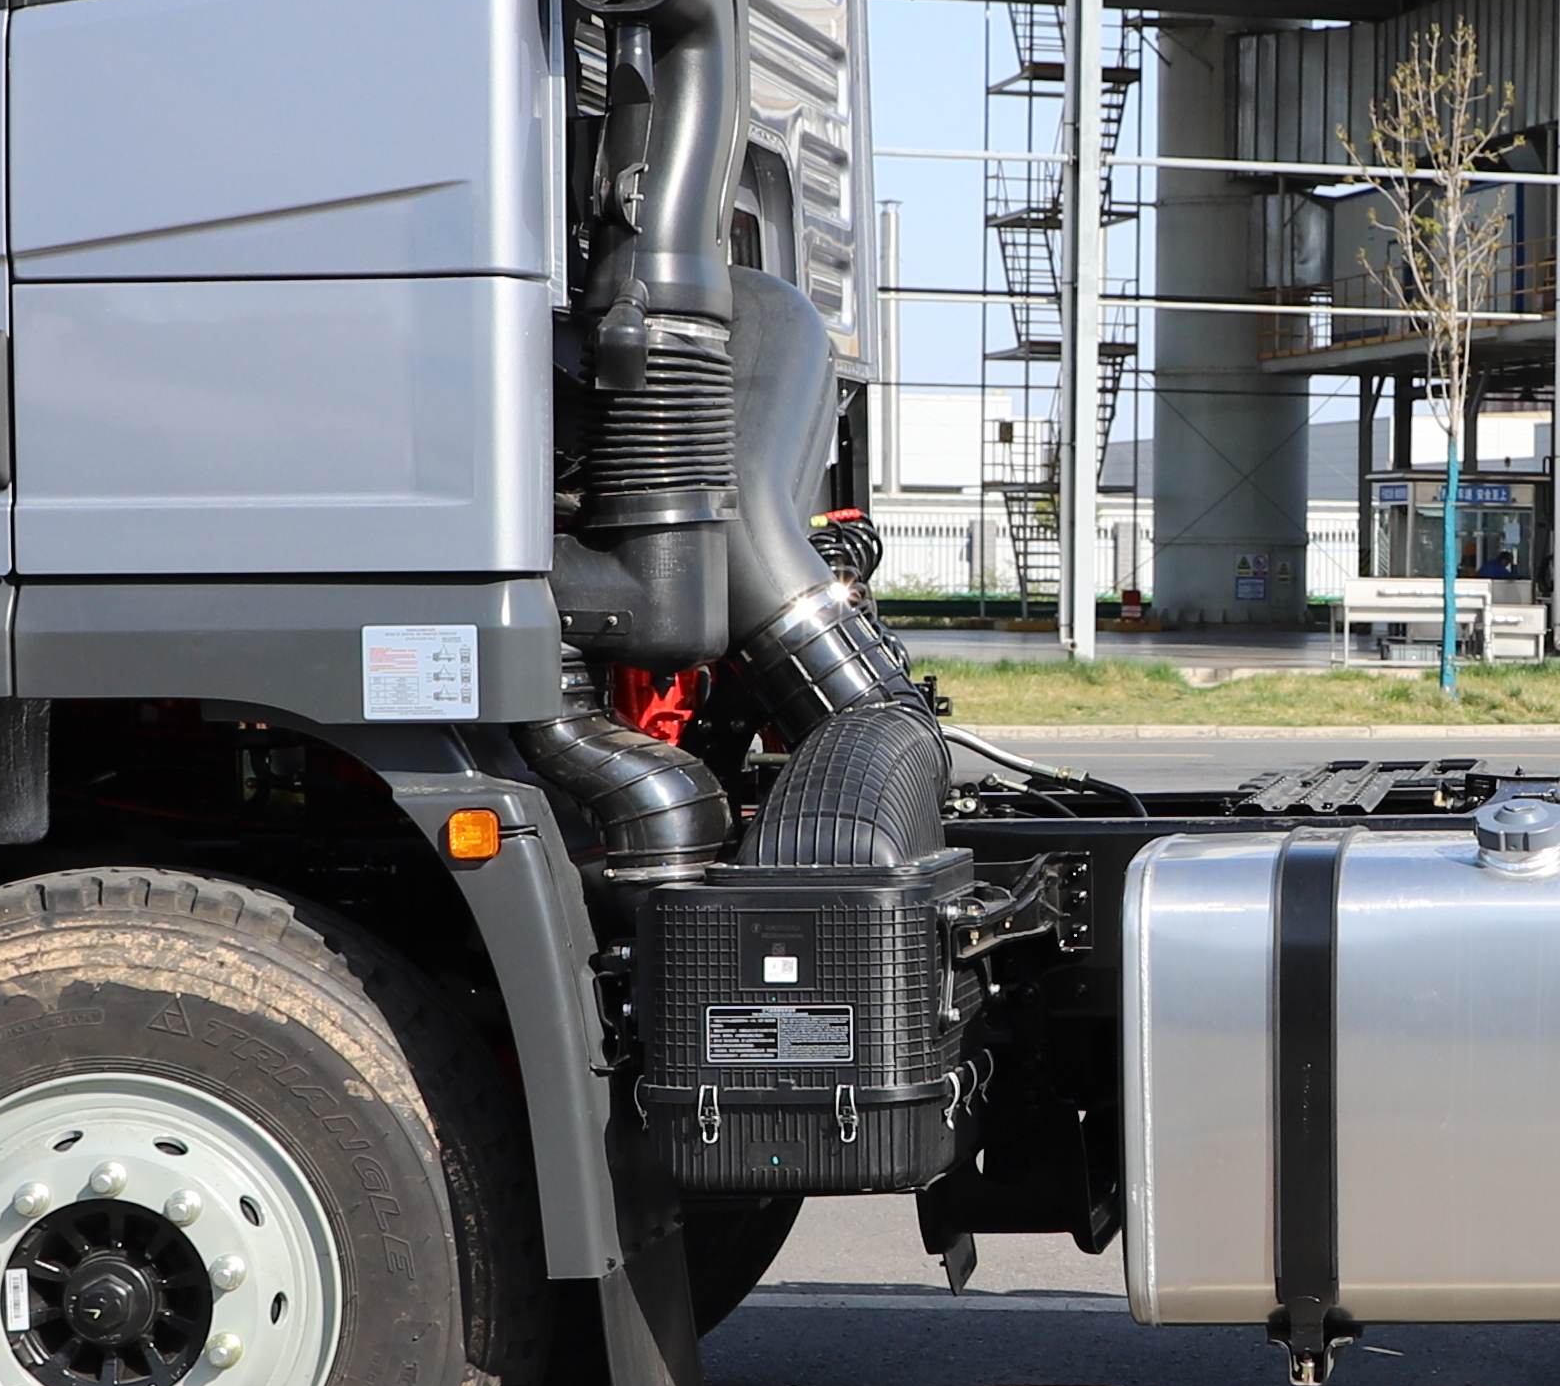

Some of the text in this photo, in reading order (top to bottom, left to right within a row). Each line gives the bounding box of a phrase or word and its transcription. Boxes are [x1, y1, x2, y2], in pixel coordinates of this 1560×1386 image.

[1477, 488, 1507, 501] 安全至上
[199, 1007, 415, 1283] TRIANGLE
